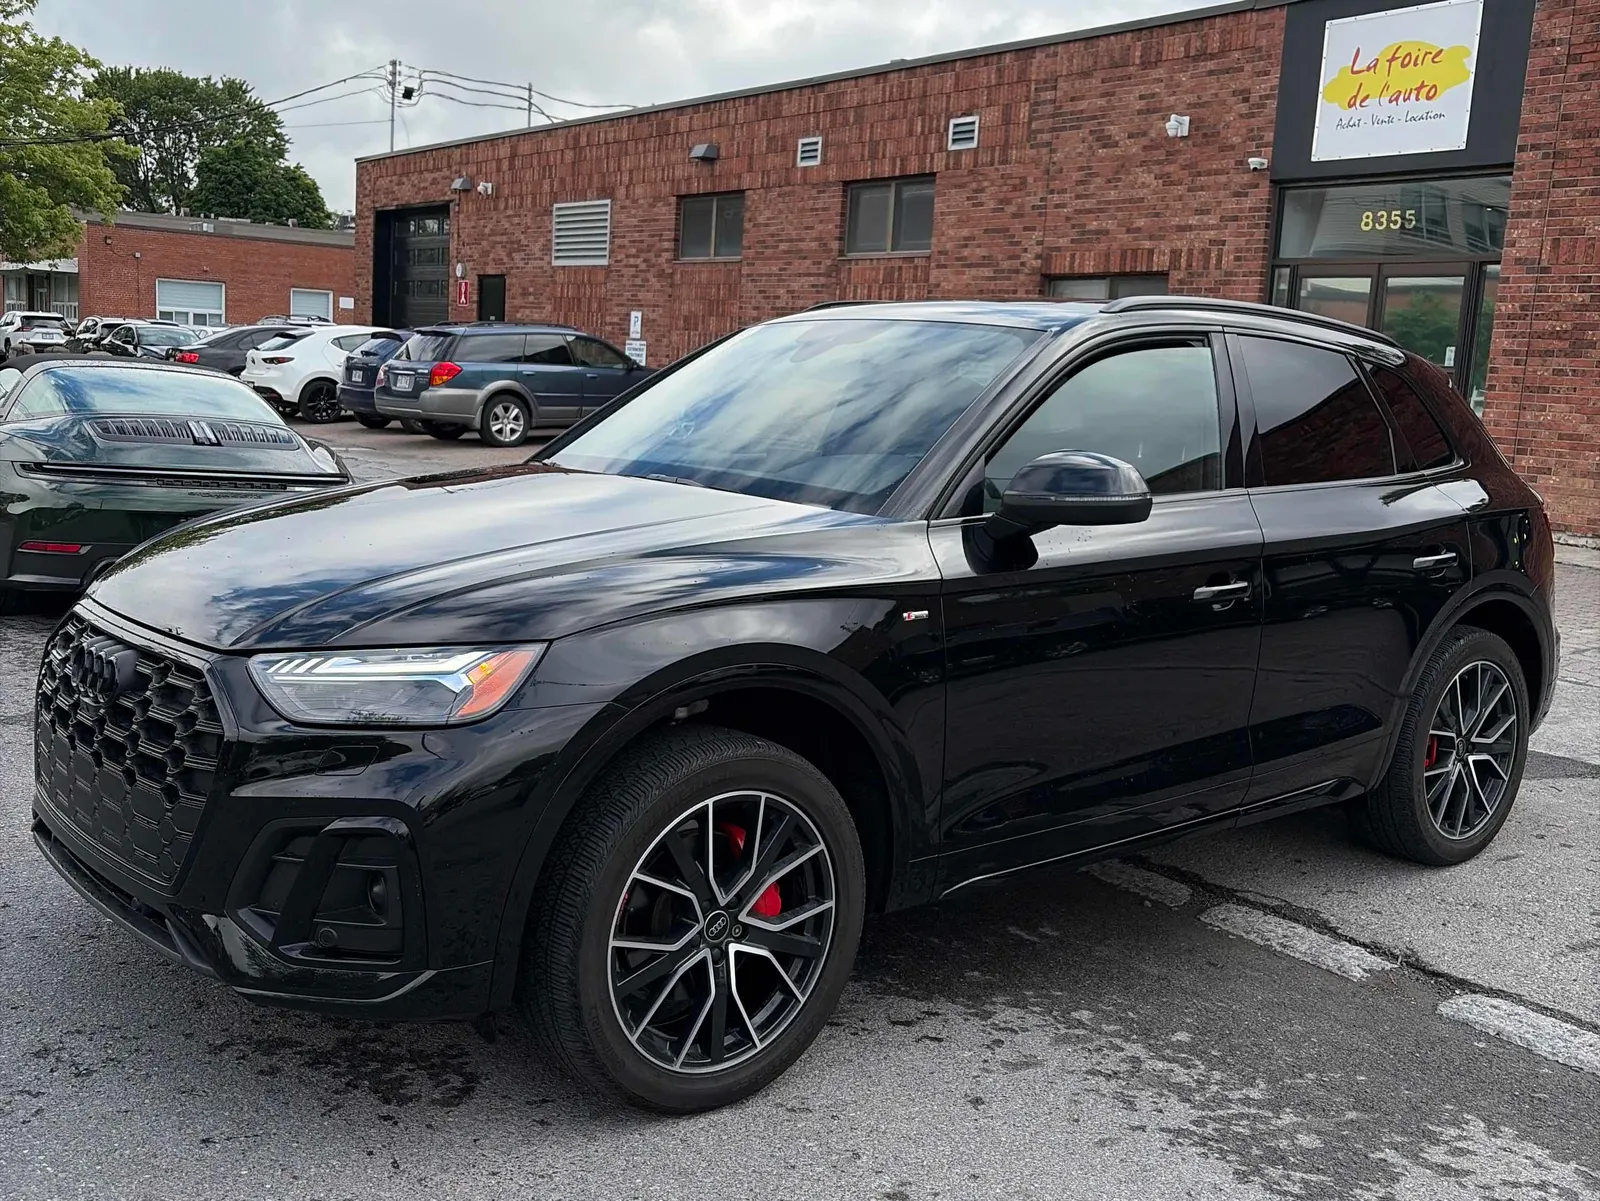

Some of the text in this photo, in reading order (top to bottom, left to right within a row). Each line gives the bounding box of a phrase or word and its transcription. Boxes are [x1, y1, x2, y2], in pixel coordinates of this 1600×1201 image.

[1350, 45, 1444, 77] La foire
[1348, 80, 1438, 110] de l'auto
[1335, 116, 1362, 131] Achat
[1371, 113, 1395, 127] Vente
[1404, 110, 1446, 123] Location
[1360, 209, 1416, 231] 8355
